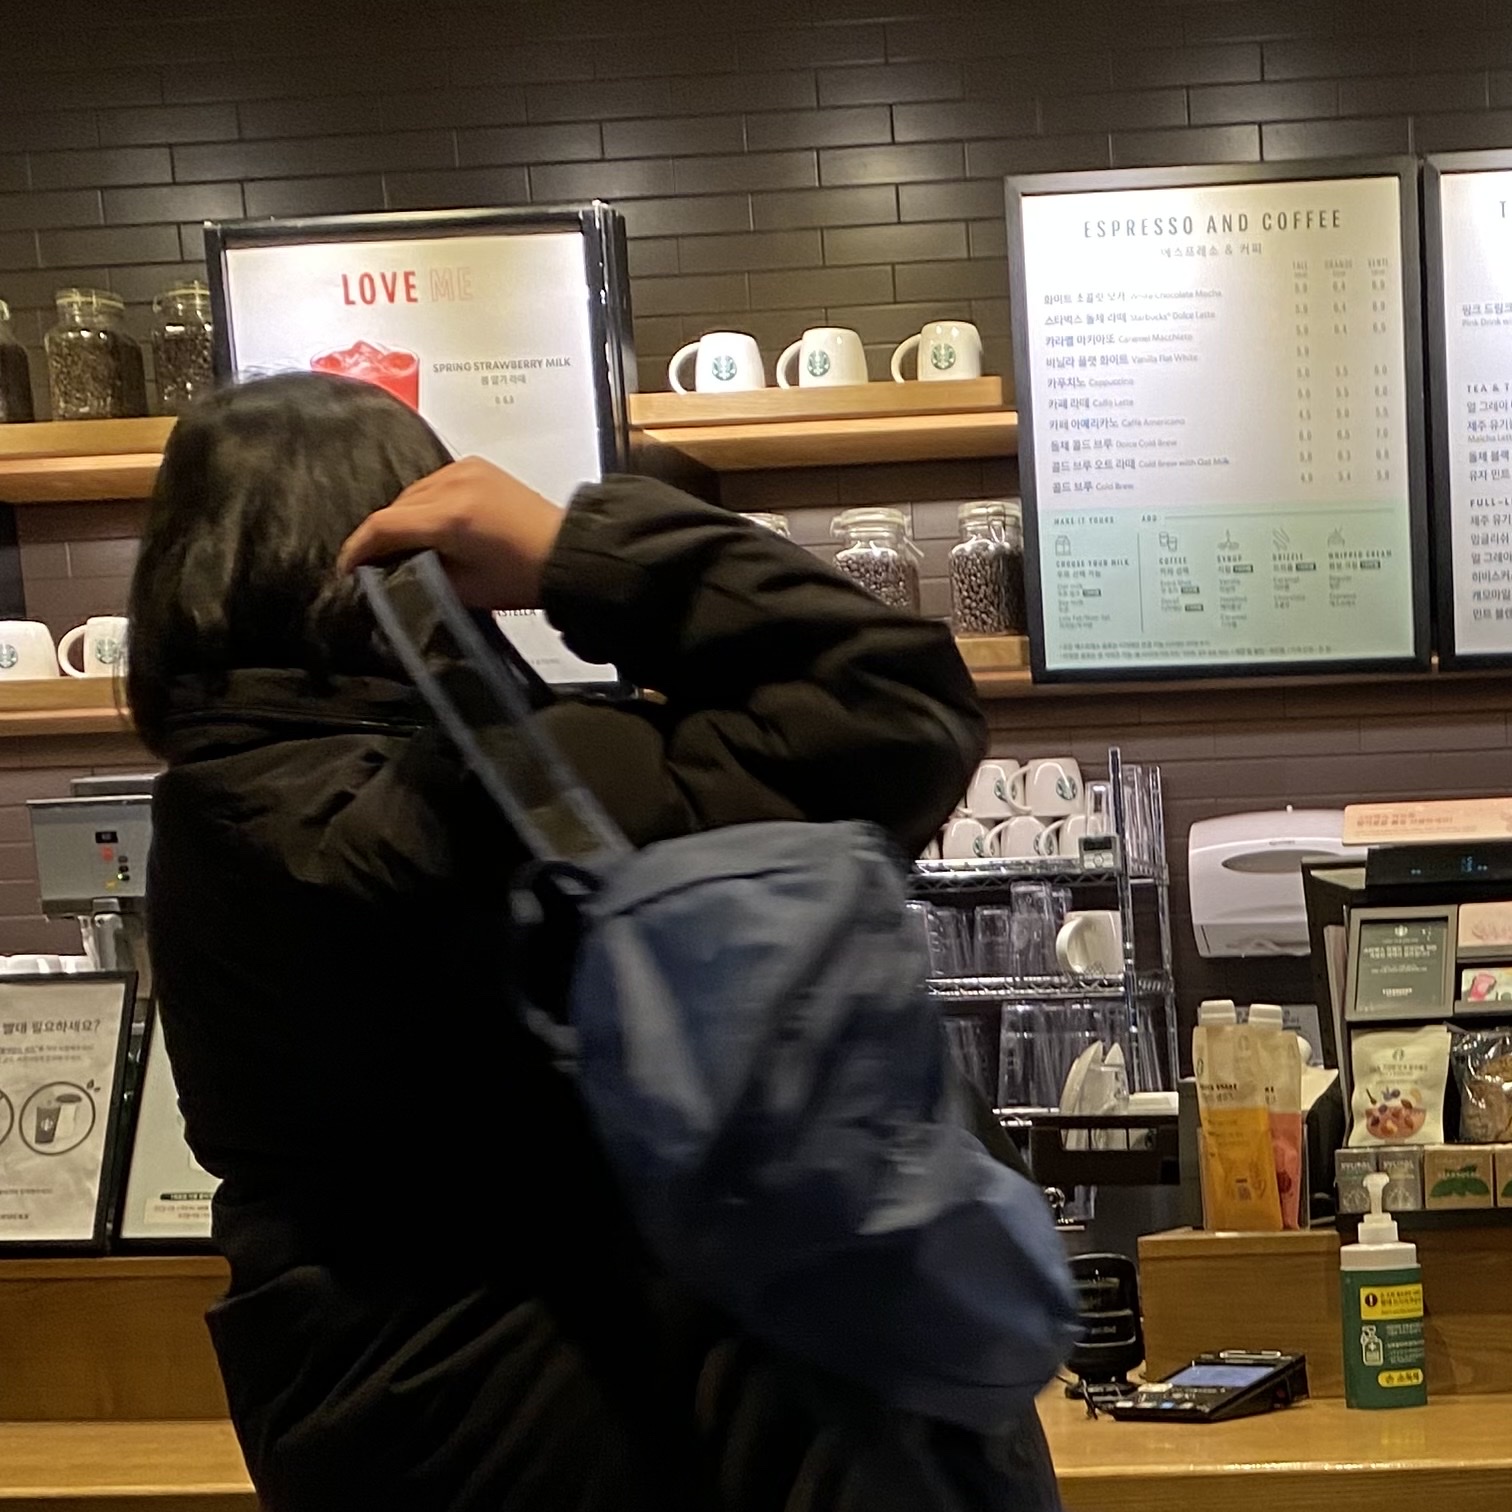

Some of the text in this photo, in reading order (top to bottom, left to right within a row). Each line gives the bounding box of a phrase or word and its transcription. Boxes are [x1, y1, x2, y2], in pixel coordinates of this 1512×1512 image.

[1084, 209, 1341, 238] ESPRESSO AND COFFEE
[1240, 242, 1263, 256] 커피
[342, 267, 473, 305] LOVE ME
[433, 357, 571, 373] SPRING STRAWBERRY MILK
[1046, 356, 1074, 368] 바닐라
[1100, 354, 1129, 366] 화이트
[1047, 376, 1086, 389] 카푸치노
[1467, 384, 1488, 394] TEA
[1049, 398, 1068, 410] 카페
[1071, 417, 1119, 430] 아메리카노
[1093, 438, 1113, 449] 브루
[1073, 460, 1092, 472] 브루
[1094, 459, 1113, 470] 오트
[1469, 469, 1487, 480] 유자
[1074, 481, 1093, 492] 브루
[3, 1020, 100, 1034] 빨대 필요하세요?
